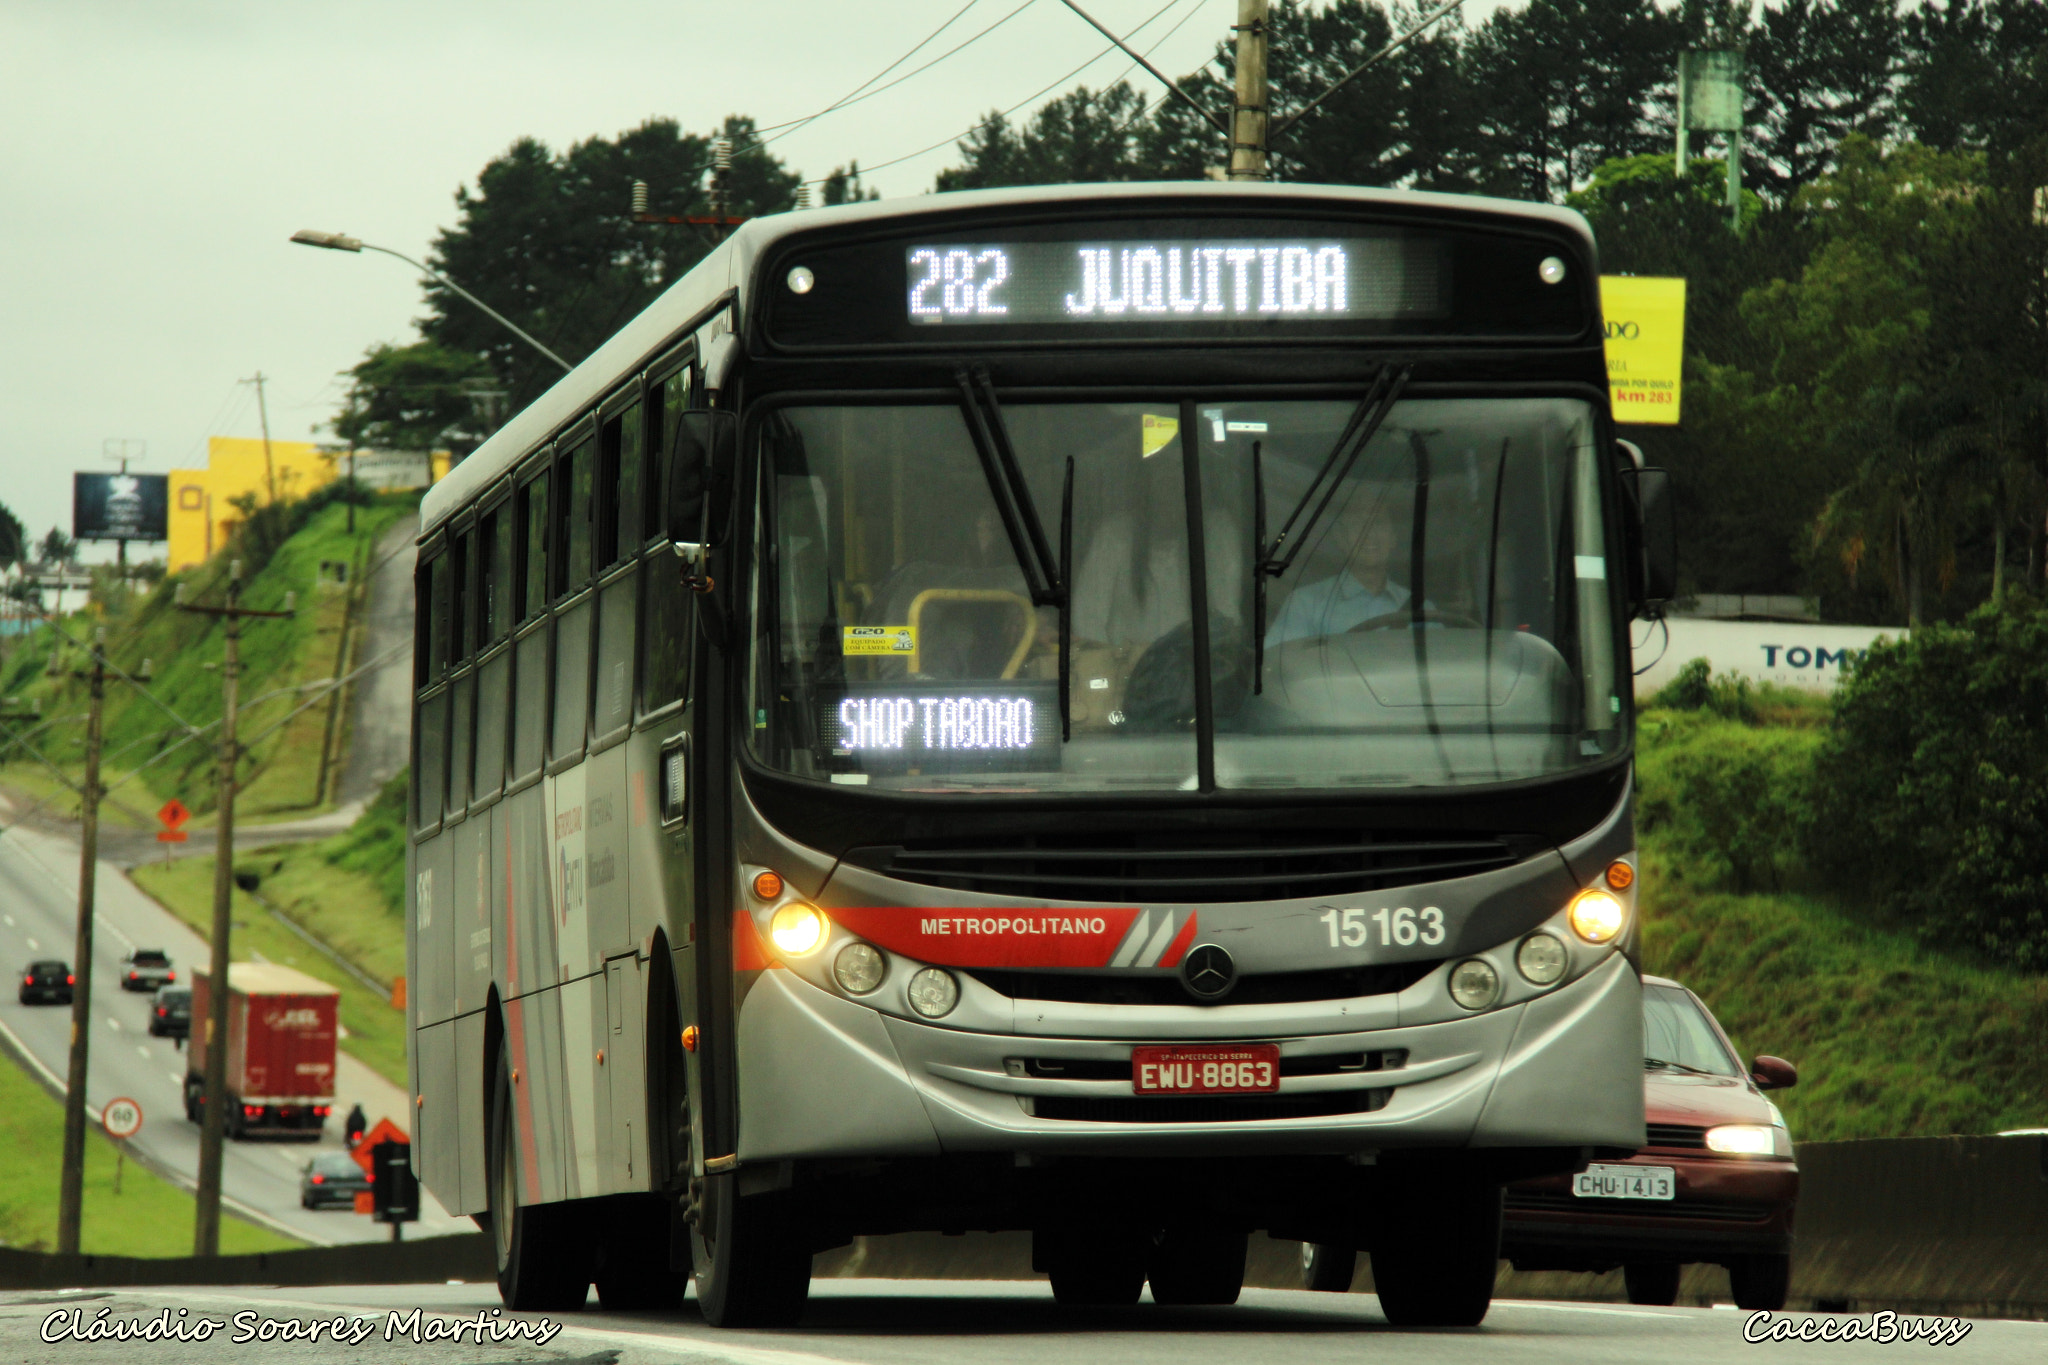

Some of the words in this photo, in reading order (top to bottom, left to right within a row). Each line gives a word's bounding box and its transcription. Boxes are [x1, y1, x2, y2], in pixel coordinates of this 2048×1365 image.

[910, 249, 1009, 314] 282
[1066, 246, 1348, 314] JUQUITIBA
[1617, 389, 1645, 402] km
[1648, 391, 1673, 404] 283
[840, 698, 914, 748] SHOP
[921, 917, 1106, 935] METROPOLITANO
